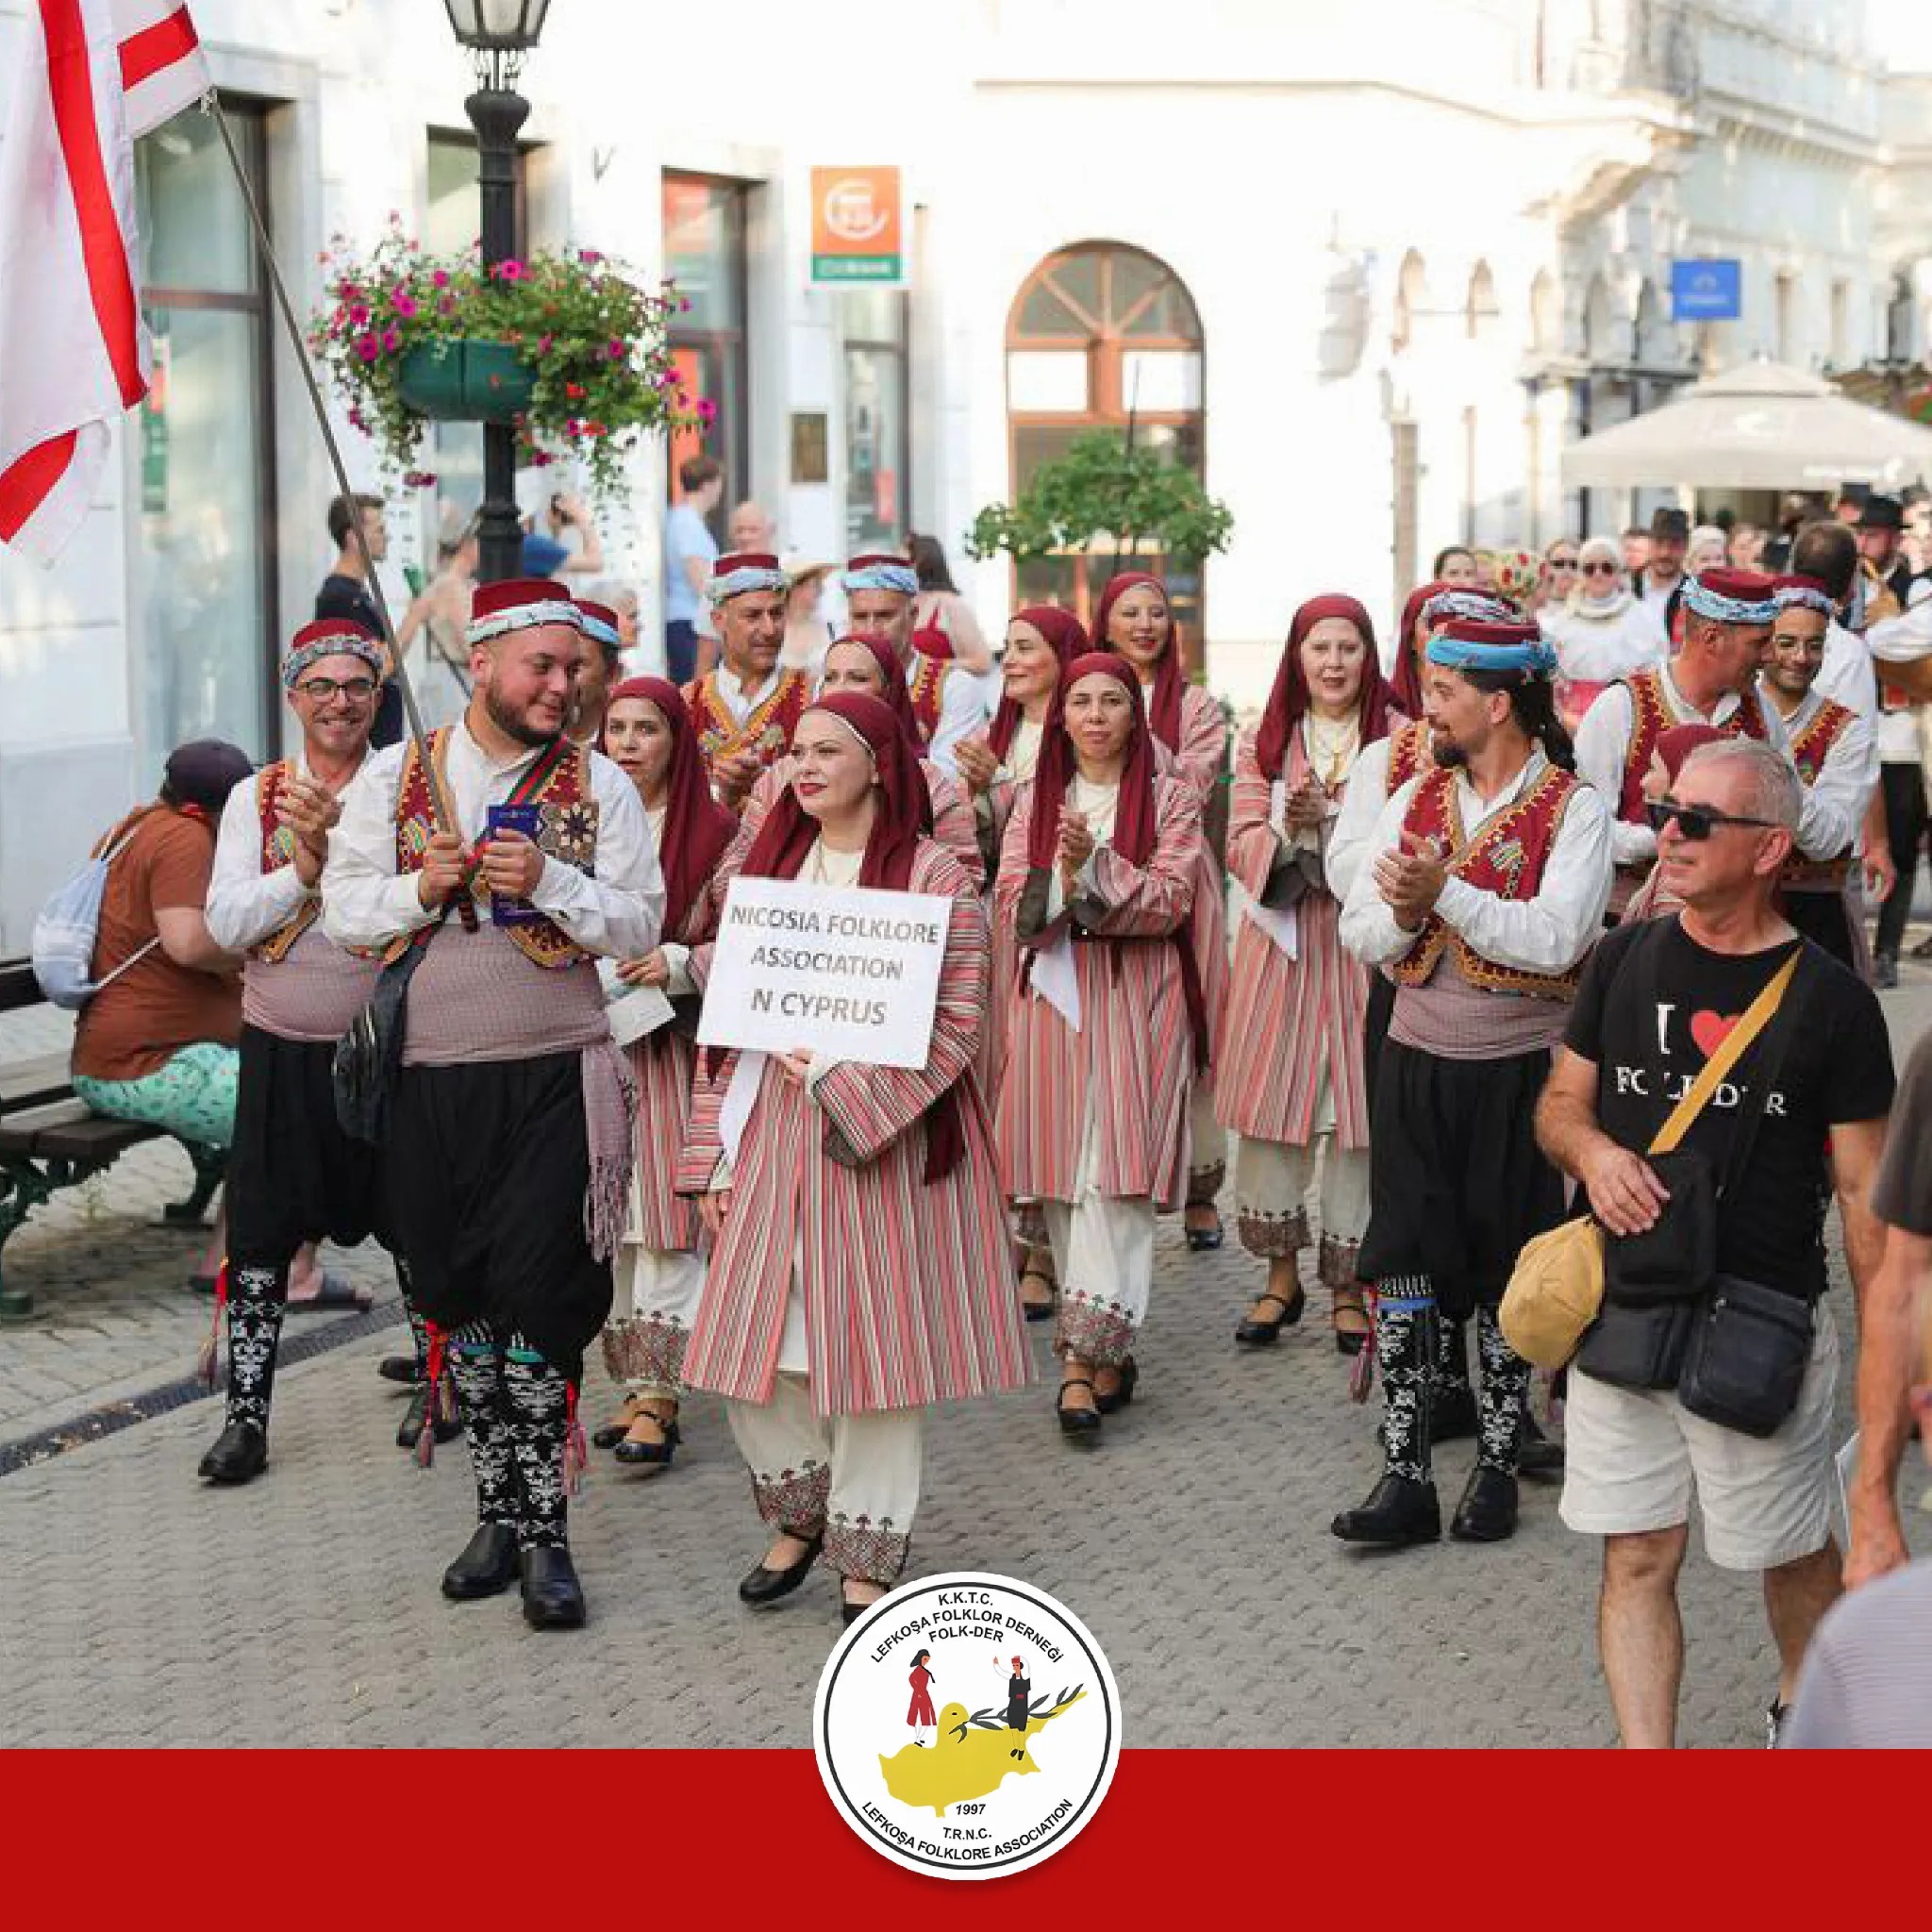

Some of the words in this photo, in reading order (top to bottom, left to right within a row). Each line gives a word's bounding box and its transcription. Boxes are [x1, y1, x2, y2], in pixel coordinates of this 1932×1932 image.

[731, 905, 820, 932] NICOSIA
[827, 914, 939, 943] FOLKLORE
[751, 945, 903, 979] ASSOCIATION
[751, 989, 773, 1012] N
[781, 992, 887, 1025] CYPRUS
